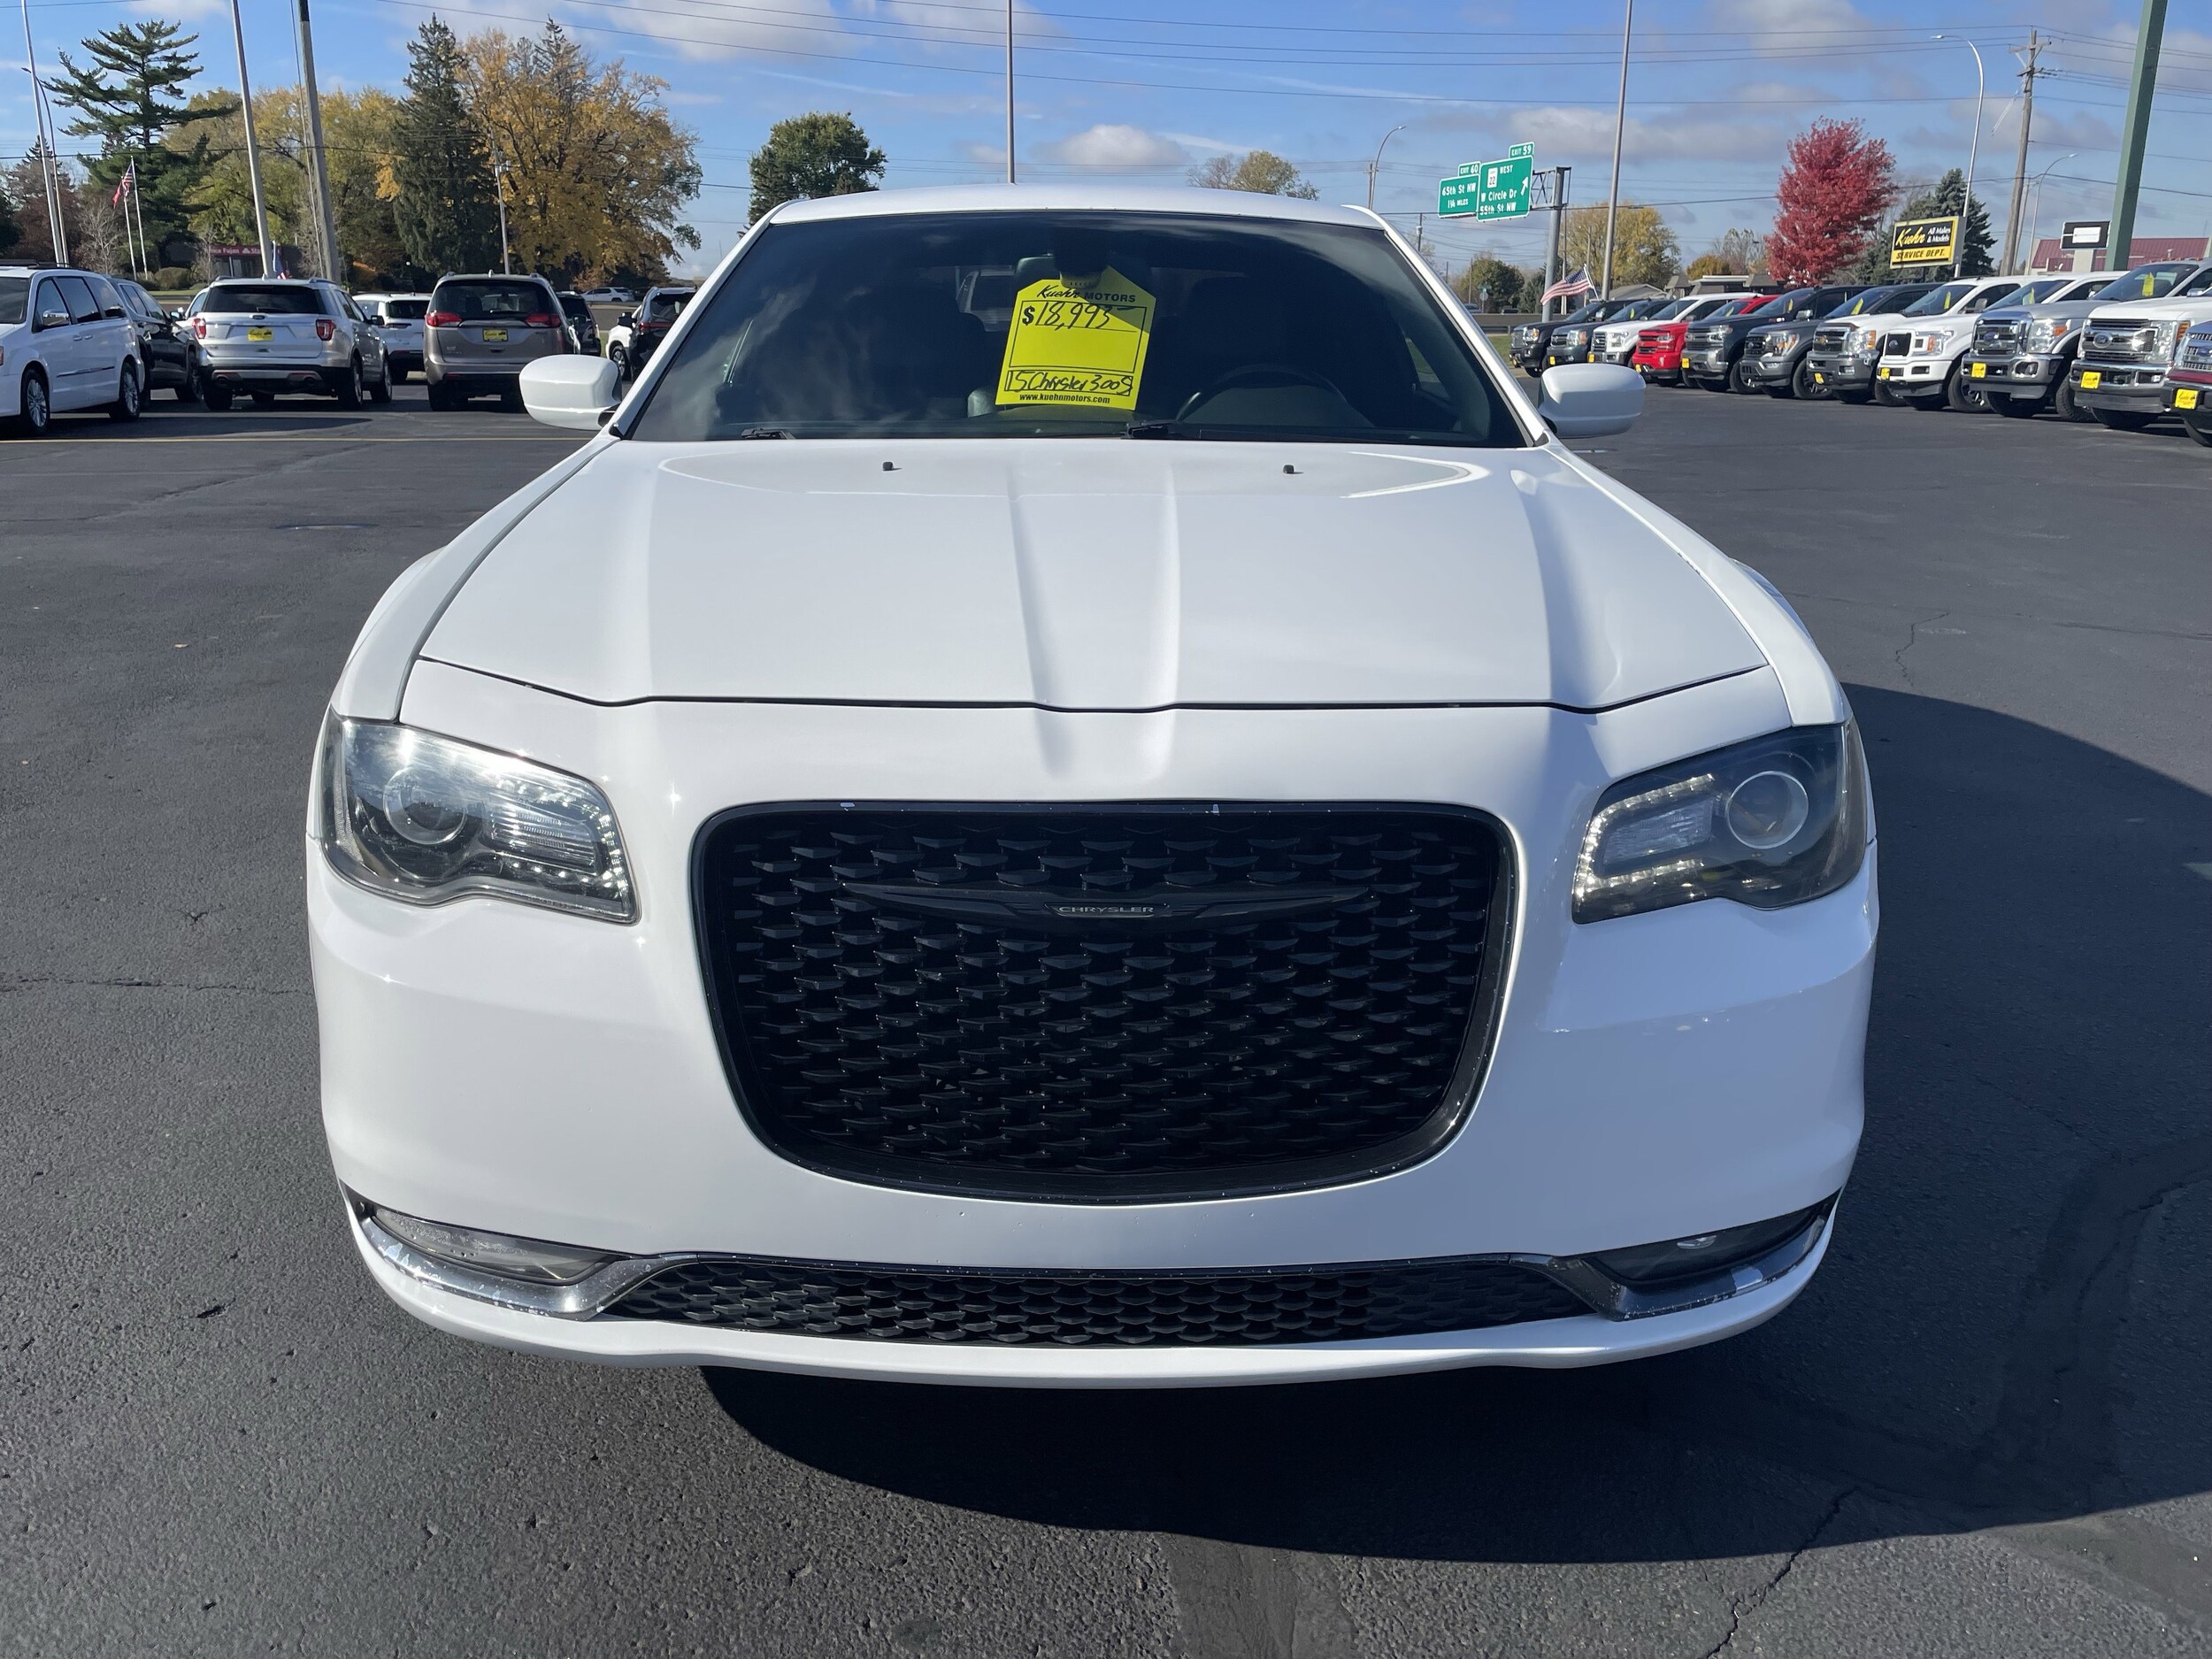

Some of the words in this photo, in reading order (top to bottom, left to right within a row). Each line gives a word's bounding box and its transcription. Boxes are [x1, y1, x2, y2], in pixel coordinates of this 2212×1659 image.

[1523, 145, 1532, 156] 59
[1471, 165, 1479, 174] 60
[1500, 165, 1513, 174] WEST
[1488, 176, 1496, 186] 22
[1442, 186, 1456, 196] 65th
[1458, 184, 1465, 194] St
[1467, 182, 1477, 193] NW
[1480, 192, 1486, 203] W
[1488, 189, 1507, 202] Circle
[1509, 188, 1517, 199] Dr
[1479, 204, 1494, 216] 55th
[1497, 204, 1504, 213] St
[1506, 202, 1517, 212] NW
[1936, 226, 1951, 234] Makes
[1895, 226, 1925, 247] Kuehn
[1932, 234, 1949, 242] Models
[1896, 250, 1924, 259] SERVICE
[1925, 248, 1945, 257] DEPT.
[1037, 284, 1079, 299] Kuehn
[1084, 291, 1136, 303] MOTORS
[1019, 392, 1111, 404] www.kuehnmotors.com
